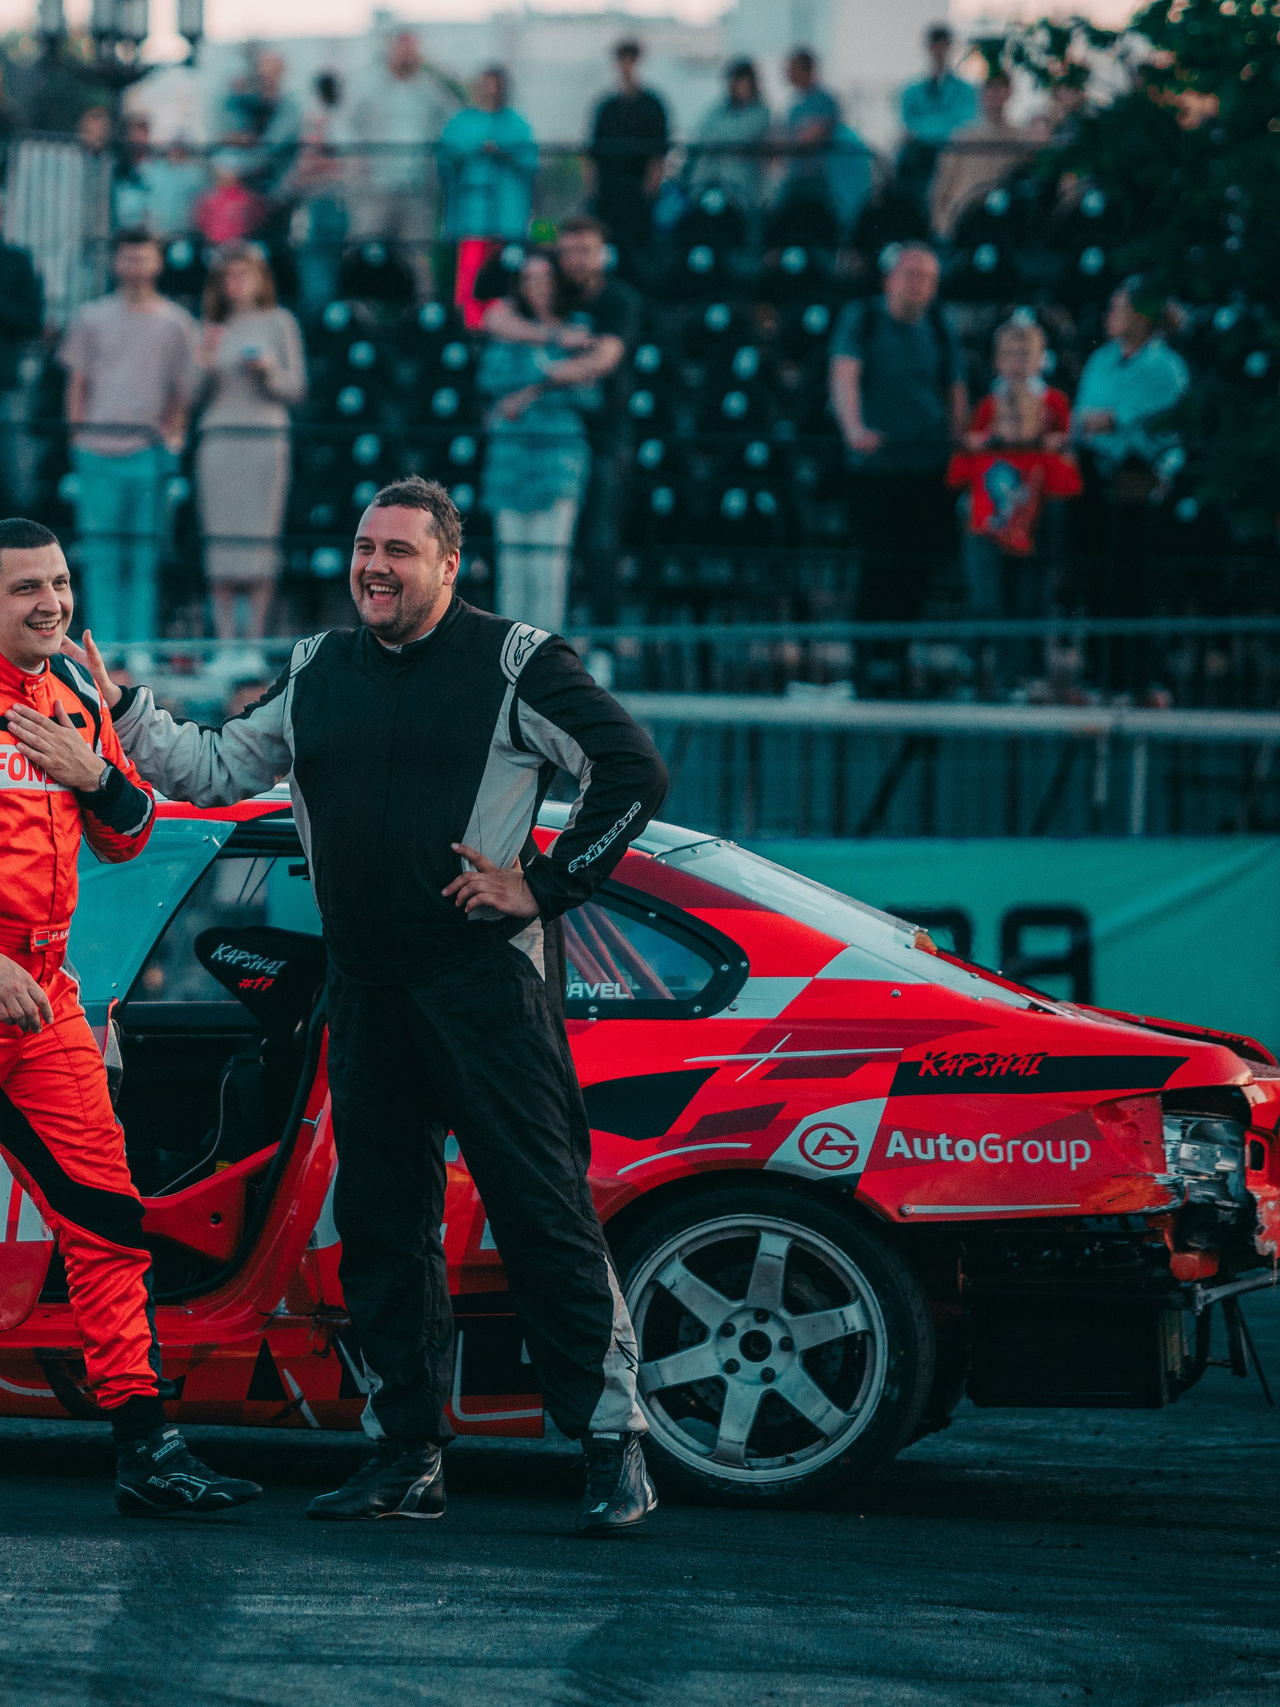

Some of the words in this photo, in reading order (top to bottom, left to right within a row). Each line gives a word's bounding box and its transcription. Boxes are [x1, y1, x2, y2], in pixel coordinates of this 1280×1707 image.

[566, 982, 630, 998] AVEL
[918, 1051, 1048, 1077] KAPSHAI
[886, 1130, 1092, 1171] AutoGroup
